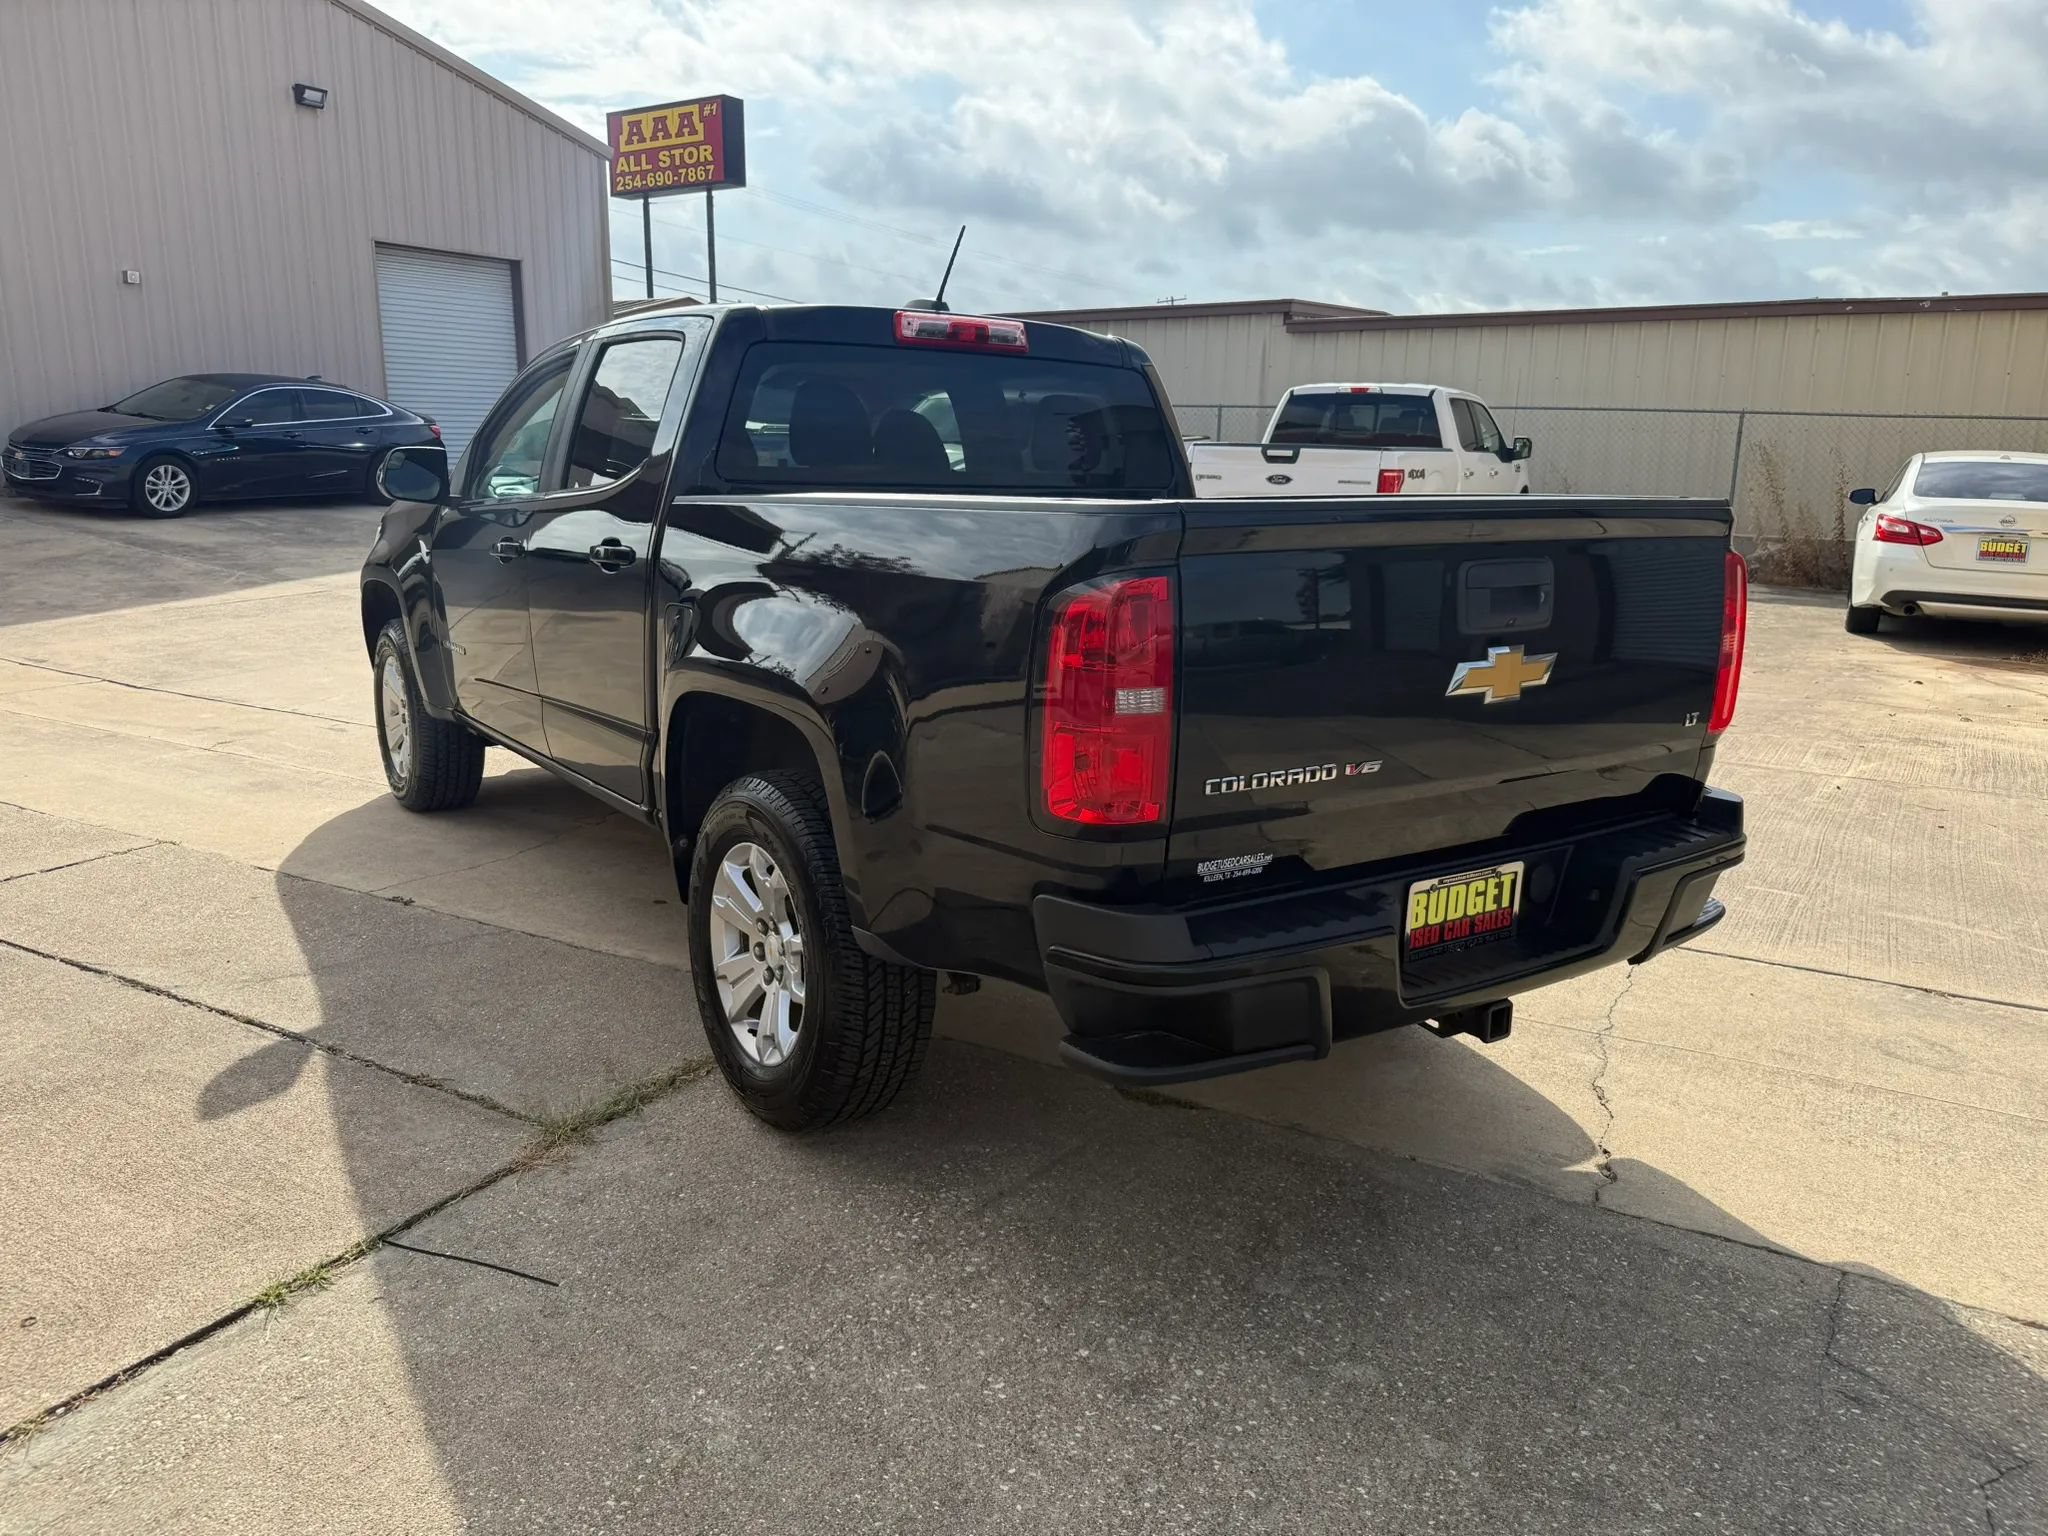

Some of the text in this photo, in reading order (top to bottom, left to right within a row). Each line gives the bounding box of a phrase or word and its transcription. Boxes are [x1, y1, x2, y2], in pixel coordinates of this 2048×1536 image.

[703, 102, 718, 117] #1
[624, 111, 699, 146] AAA
[616, 145, 714, 174] ALL STOR
[616, 165, 715, 191] 254-690-7867
[1981, 541, 2027, 553] BUDGET
[1685, 711, 1700, 727] LT
[1205, 760, 1384, 796] COLORADO V6
[1410, 872, 1516, 930] BUDGET
[1444, 917, 1471, 941] CAR
[1474, 907, 1512, 933] SALES
